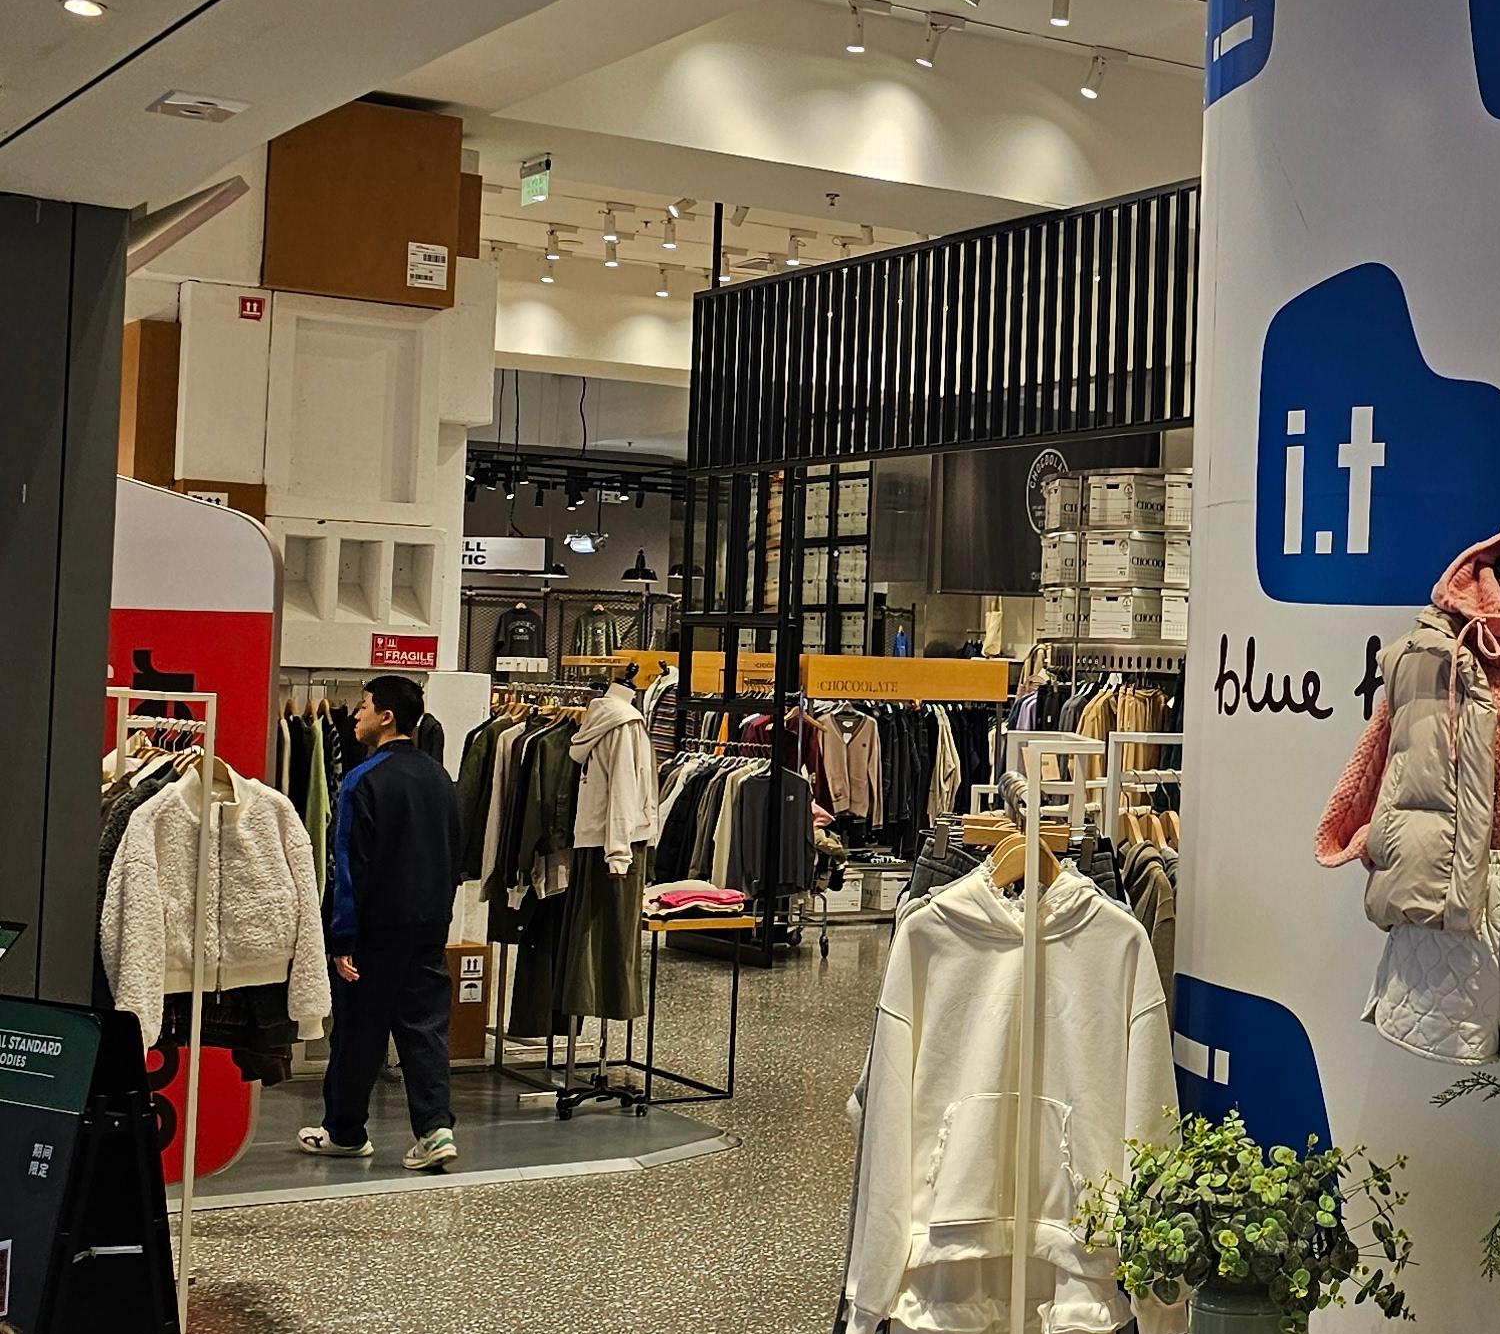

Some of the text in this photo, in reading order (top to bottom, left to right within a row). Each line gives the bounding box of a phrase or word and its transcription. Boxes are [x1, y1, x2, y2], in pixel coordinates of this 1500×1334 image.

[1283, 405, 1386, 555] i.t
[385, 651, 435, 661] FRAGILE
[1214, 633, 1334, 720] blue
[8, 1036, 62, 1056] STANDARD
